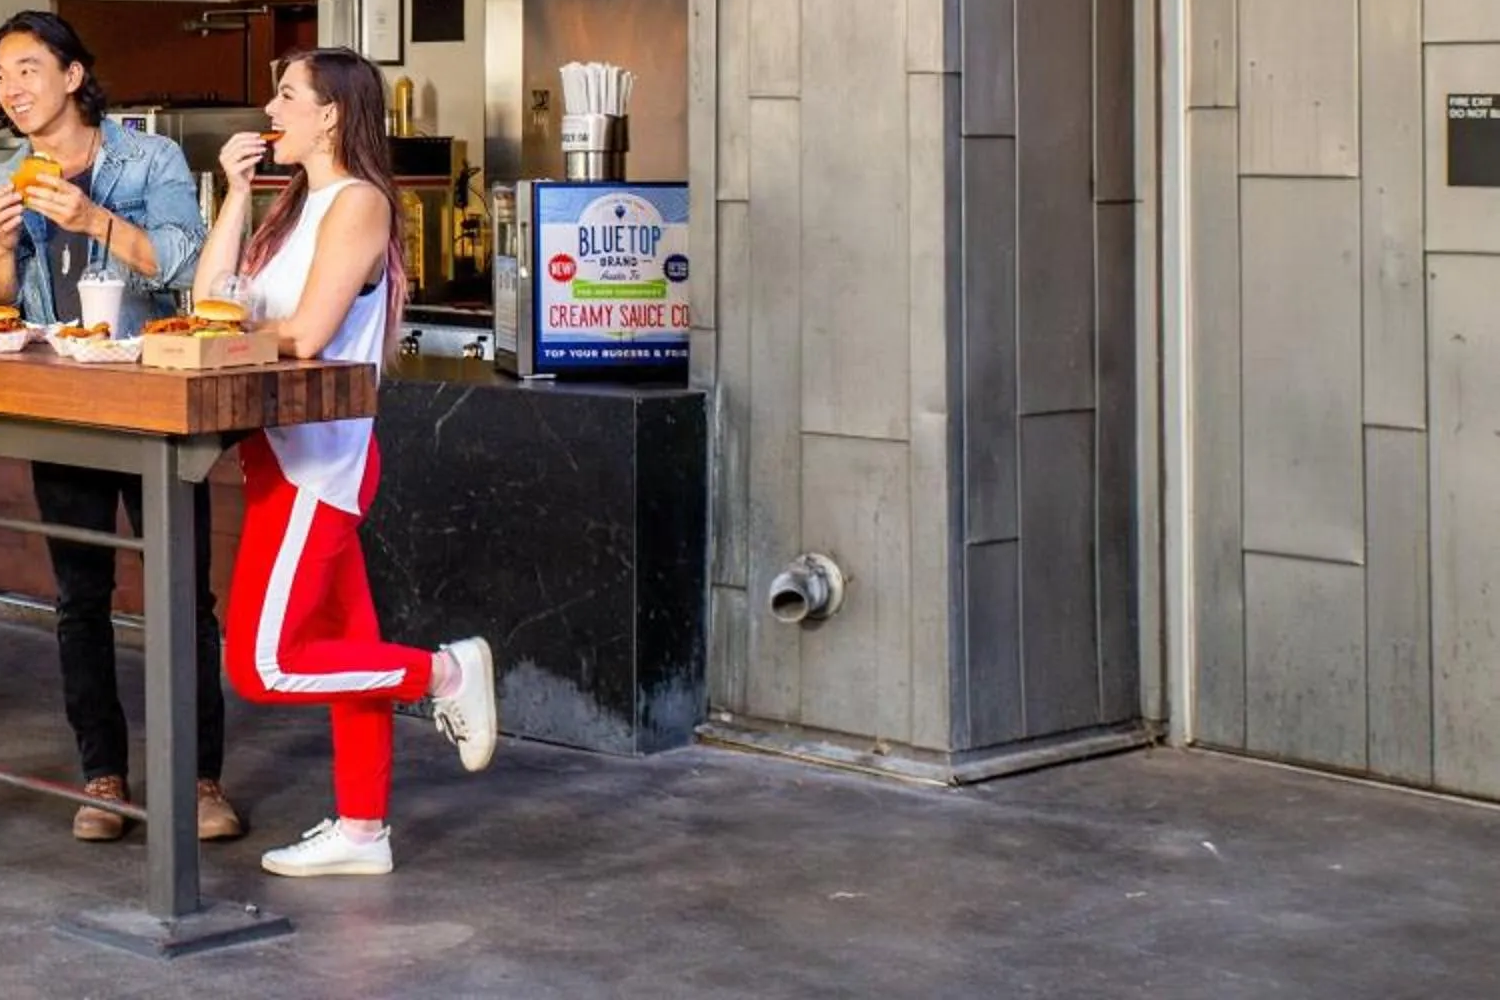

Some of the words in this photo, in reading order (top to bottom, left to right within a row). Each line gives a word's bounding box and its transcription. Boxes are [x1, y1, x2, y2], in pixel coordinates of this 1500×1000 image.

[579, 225, 661, 257] BLUETOP
[550, 304, 613, 328] CREAMY
[620, 304, 665, 328] SAUCE
[544, 349, 566, 358] TOP
[569, 349, 598, 358] YOUR
